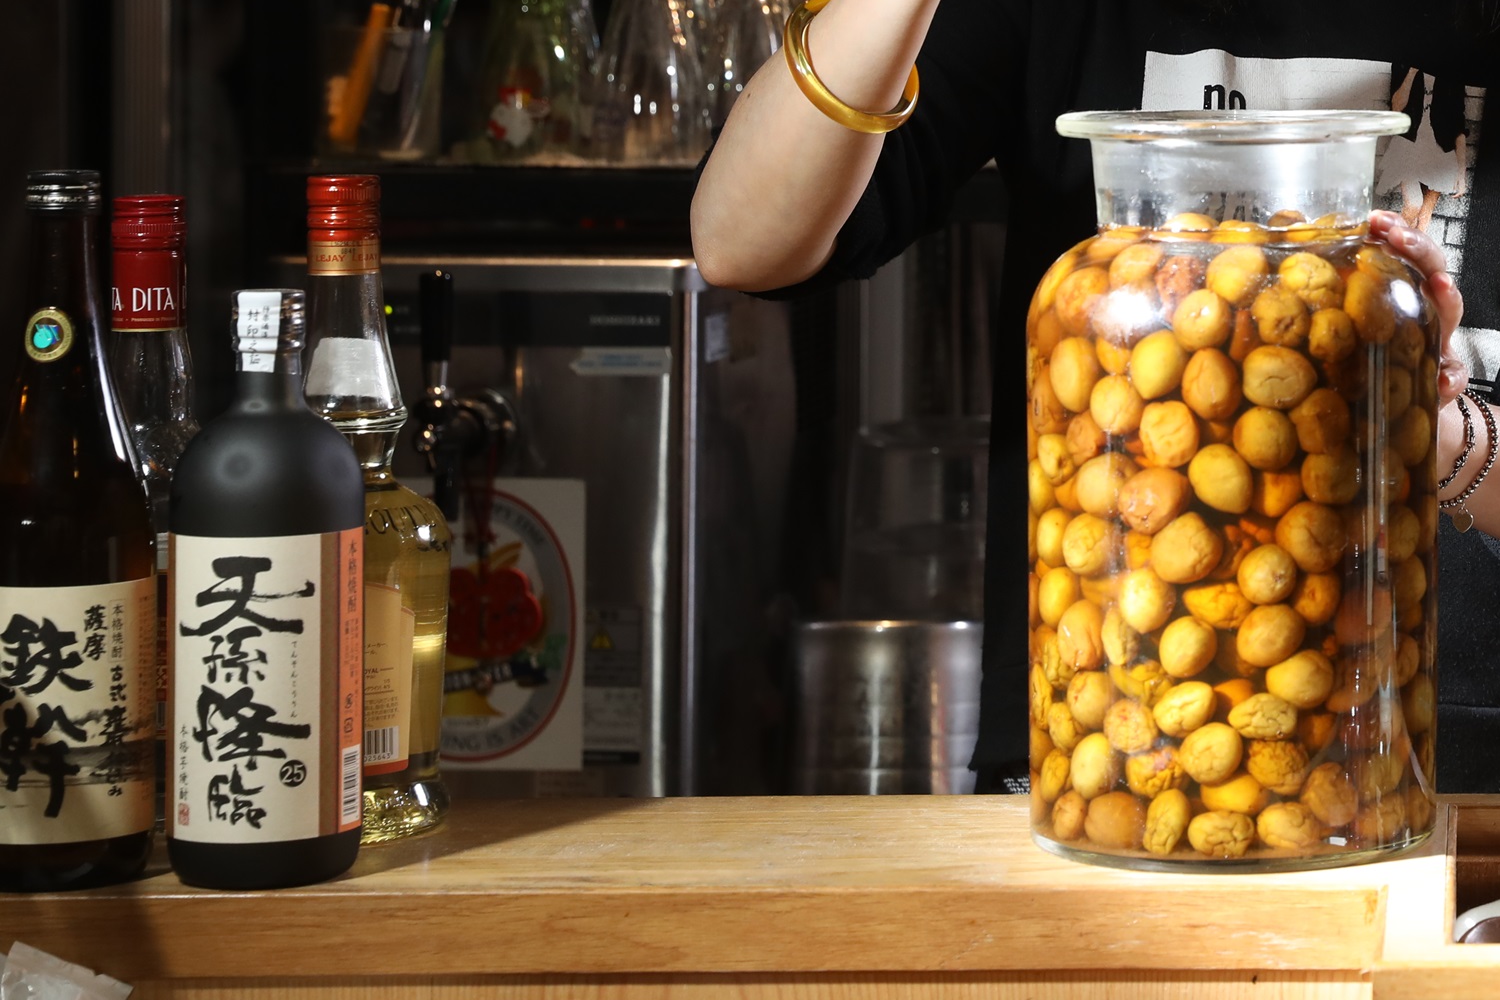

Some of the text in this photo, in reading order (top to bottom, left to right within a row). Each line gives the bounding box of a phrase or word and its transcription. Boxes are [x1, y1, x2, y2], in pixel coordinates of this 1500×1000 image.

[315, 254, 345, 262] LEJAY
[132, 287, 175, 312] DITA
[82, 603, 110, 661] 薩摩
[110, 603, 125, 658] 本格焼酎
[179, 554, 316, 830] 天孫降臨
